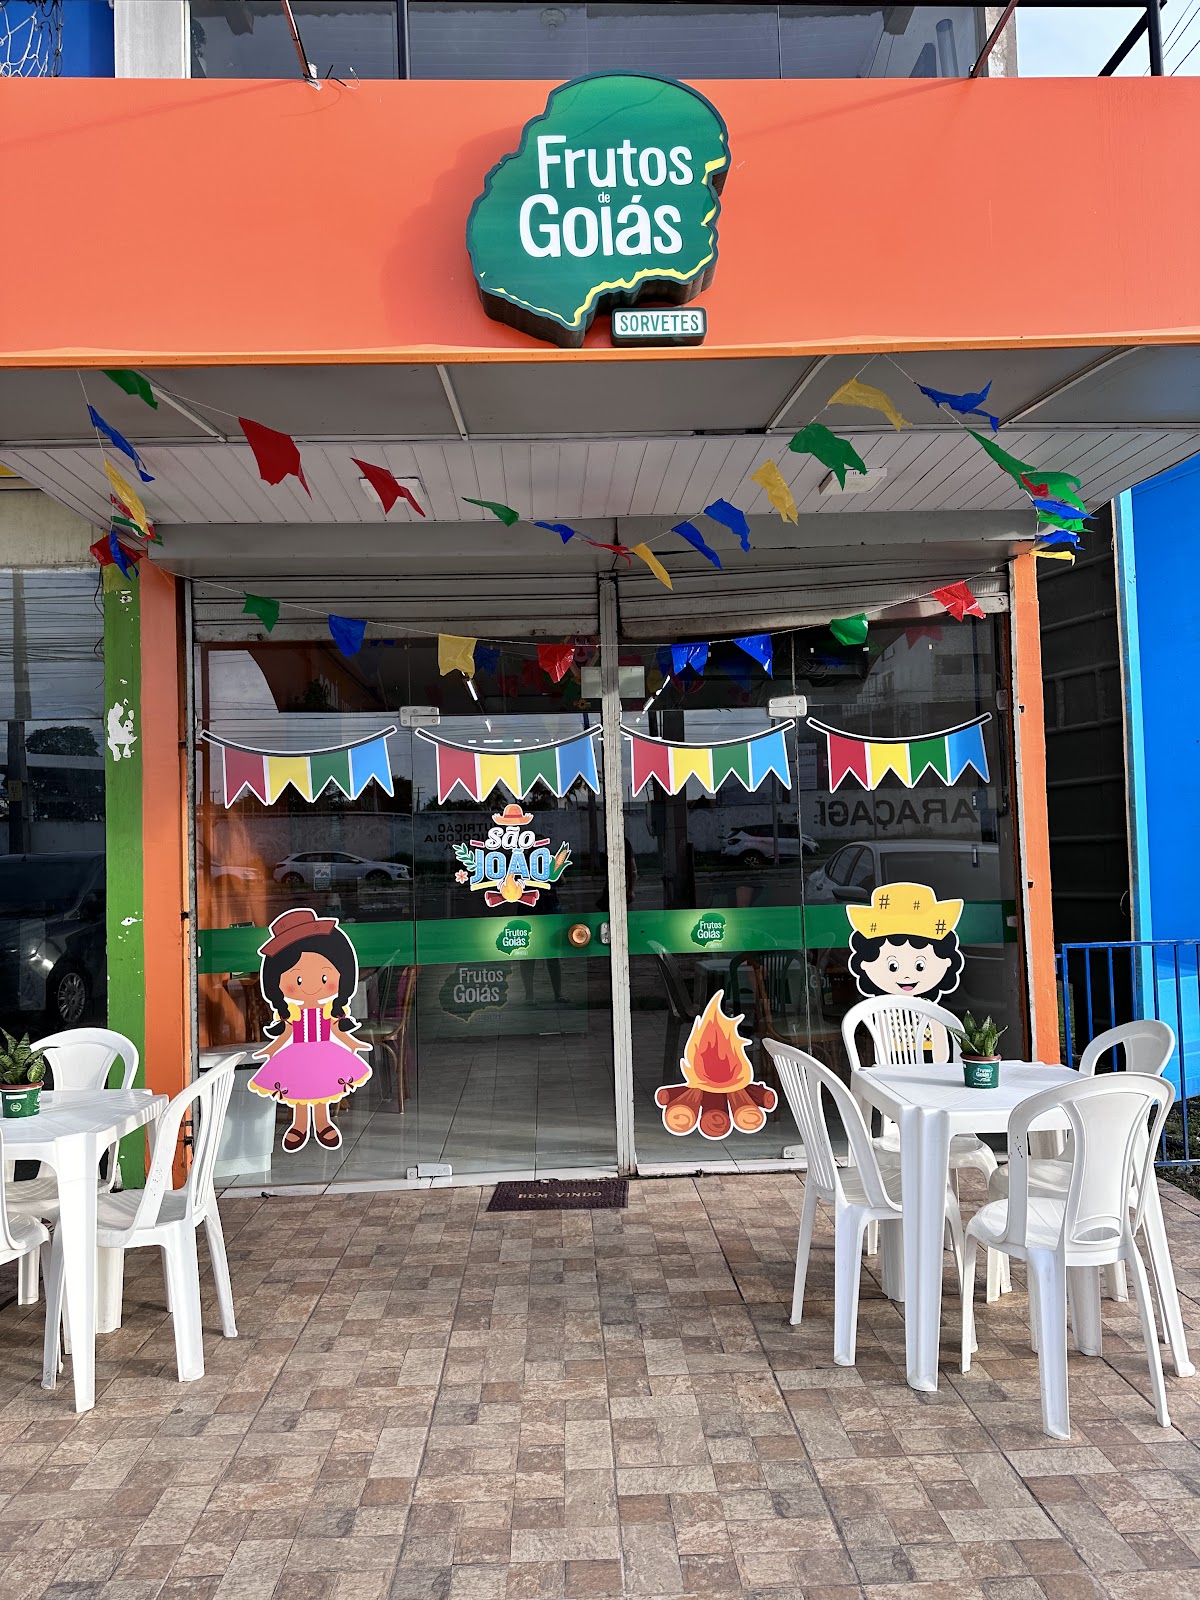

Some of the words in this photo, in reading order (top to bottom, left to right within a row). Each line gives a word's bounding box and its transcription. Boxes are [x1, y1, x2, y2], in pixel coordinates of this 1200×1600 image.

[537, 134, 694, 190] Frutos
[597, 191, 611, 203] de
[519, 193, 684, 258] Goiás
[619, 314, 700, 333] SORVETES
[485, 825, 536, 850] São
[470, 848, 551, 885] JOÃO
[505, 928, 528, 937] Frutos
[699, 920, 722, 929] Frutos
[502, 936, 526, 947] Goiás
[697, 929, 721, 939] Goiás
[459, 967, 504, 984] Frutos
[453, 983, 500, 1004] Goiás
